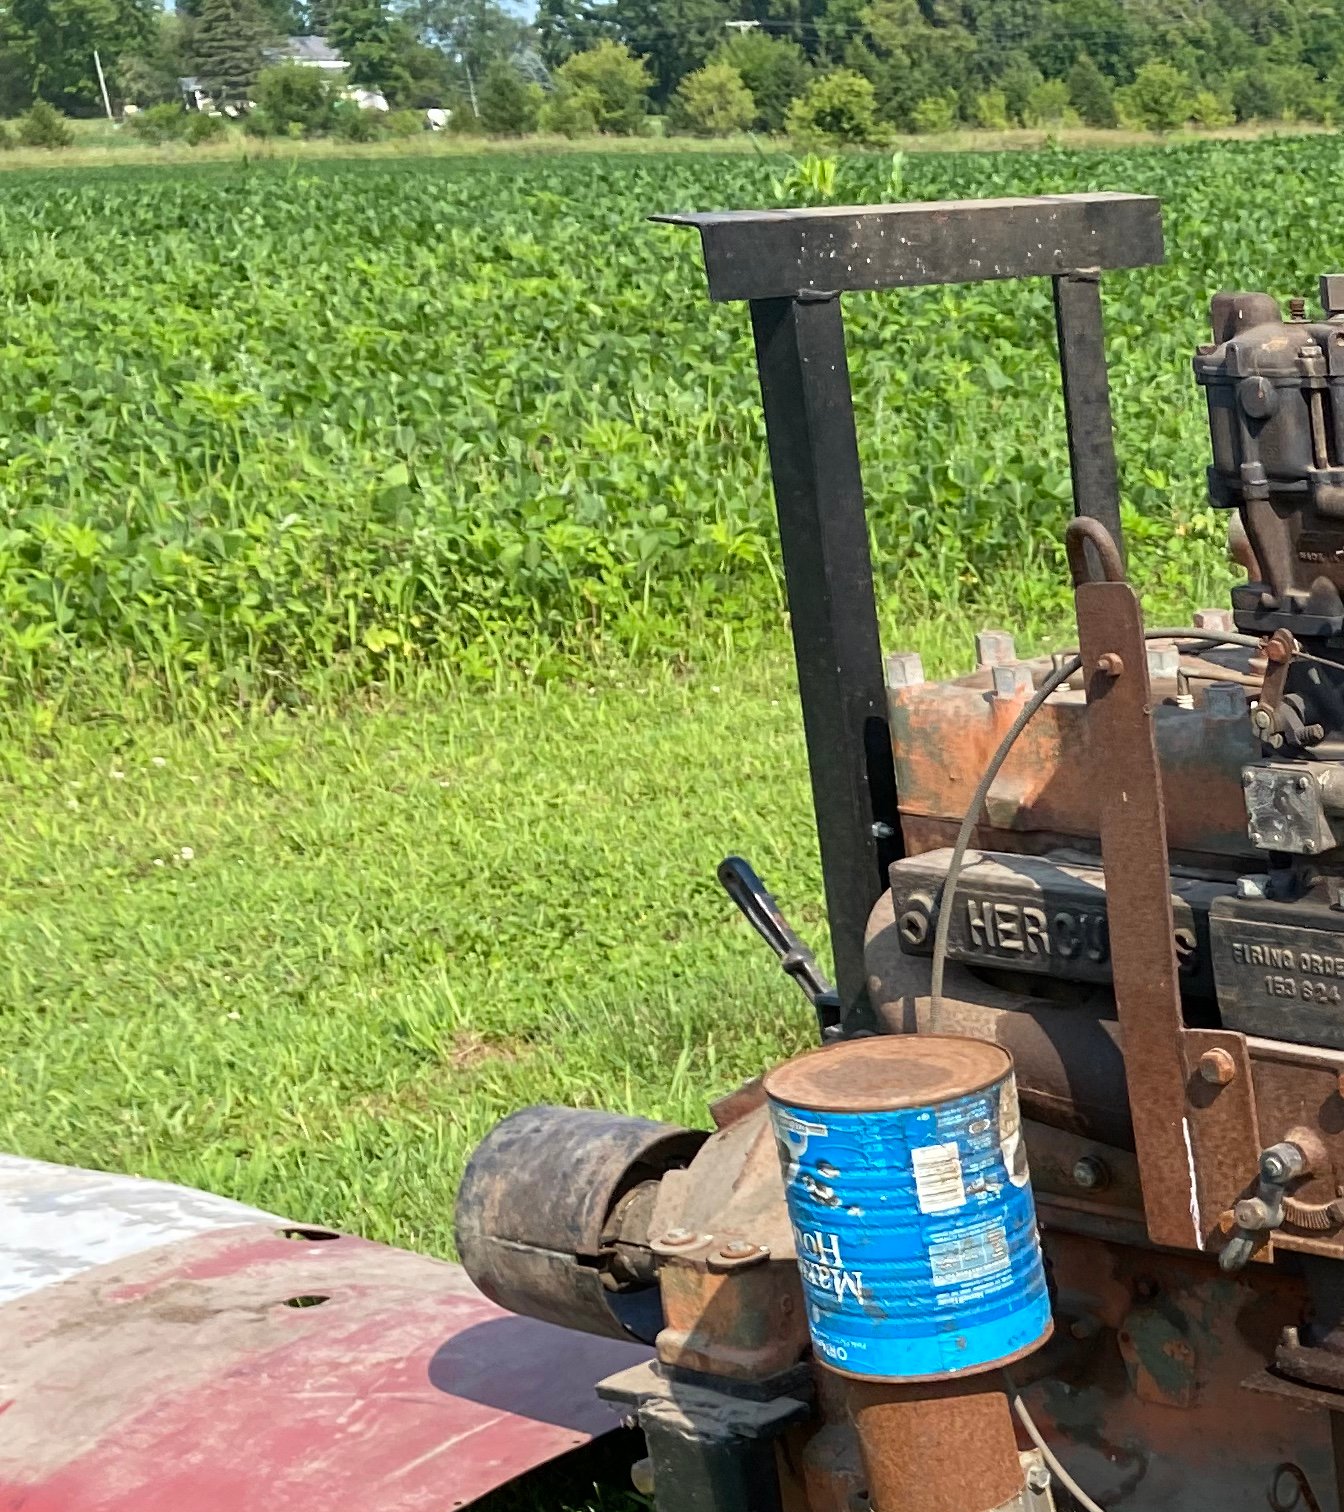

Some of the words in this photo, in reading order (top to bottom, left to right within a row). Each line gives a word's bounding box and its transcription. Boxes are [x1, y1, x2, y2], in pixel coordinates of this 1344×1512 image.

[966, 899, 1106, 961] HERCU
[1232, 942, 1295, 970] FIRING
[1264, 975, 1296, 998] 153
